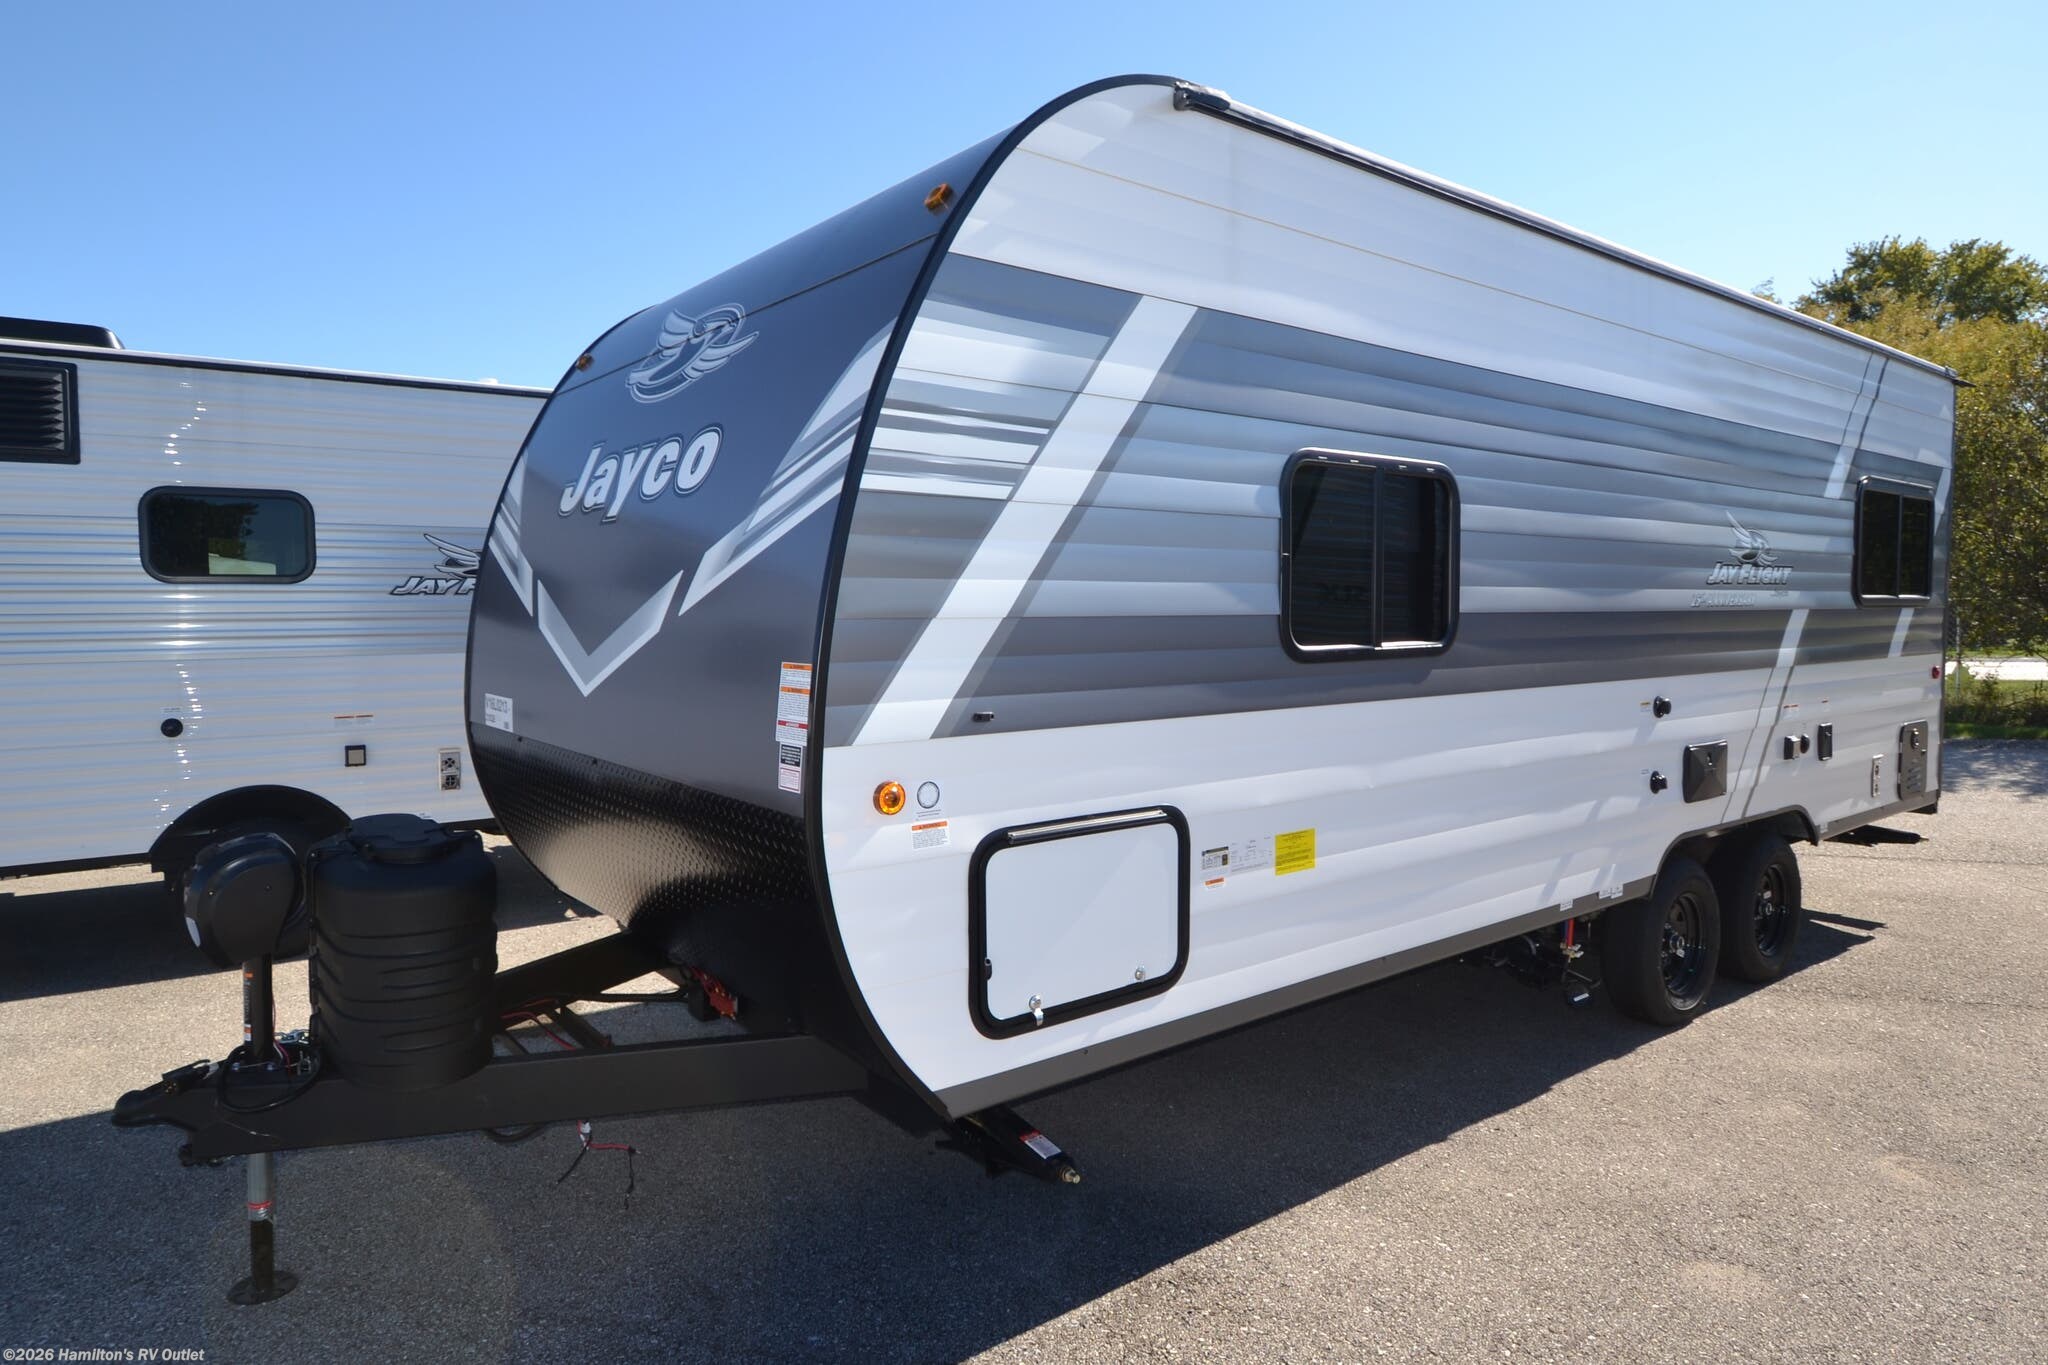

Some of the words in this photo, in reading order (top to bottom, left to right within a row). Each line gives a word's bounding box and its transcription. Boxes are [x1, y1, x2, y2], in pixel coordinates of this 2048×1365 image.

[558, 424, 723, 523] Jayco
[1706, 561, 1741, 585] JAY
[1736, 562, 1794, 585] FLIGHT
[390, 576, 462, 595] JAY
